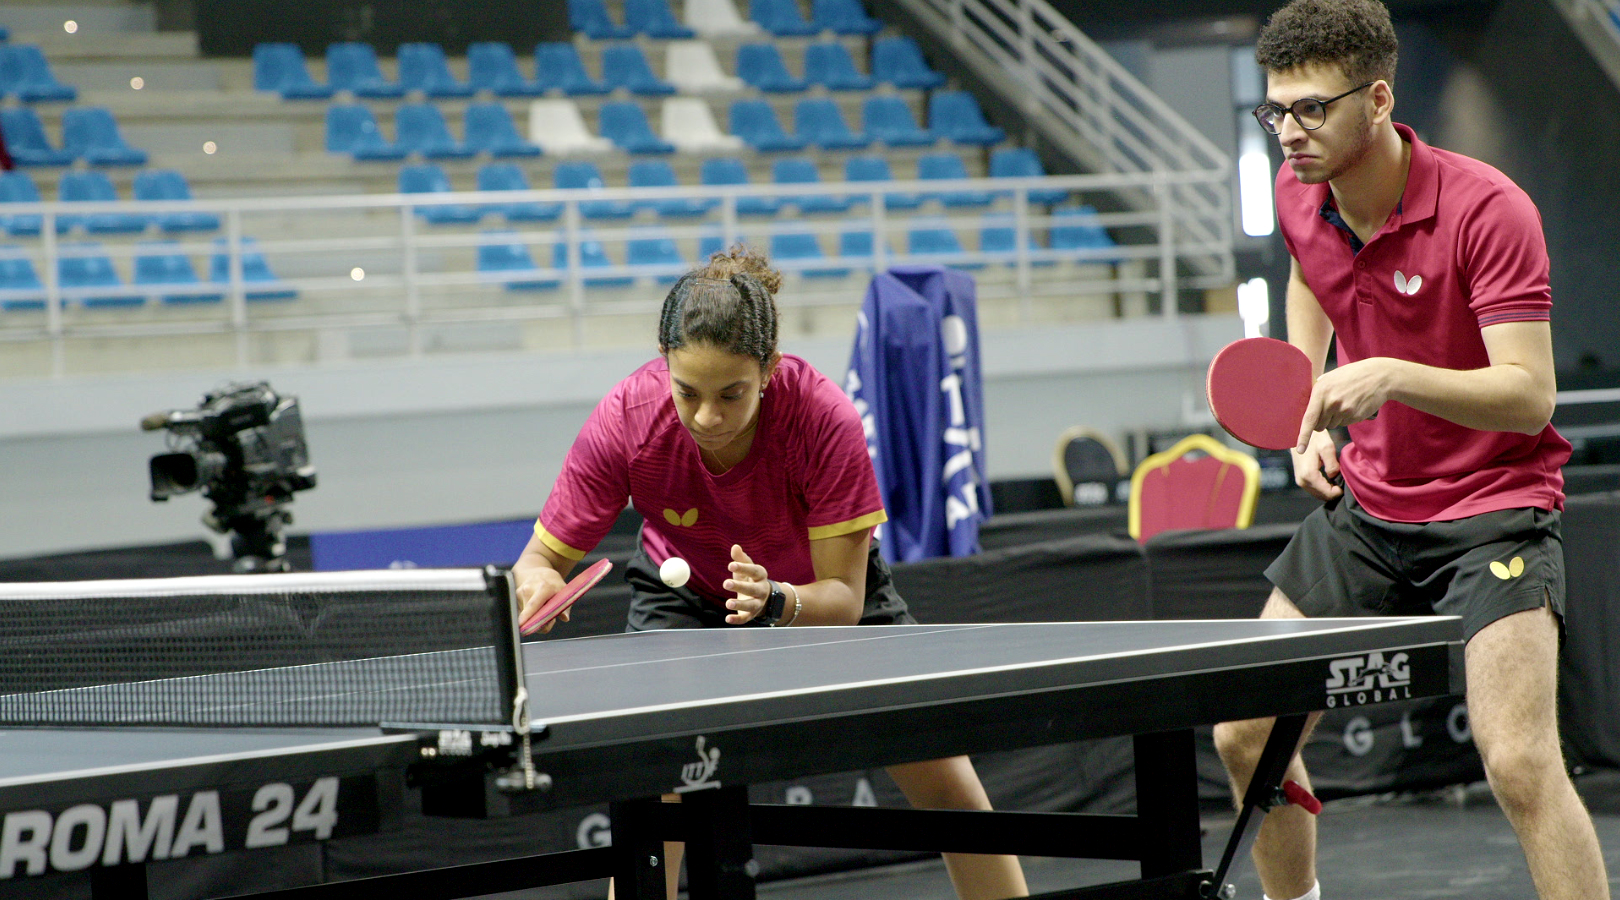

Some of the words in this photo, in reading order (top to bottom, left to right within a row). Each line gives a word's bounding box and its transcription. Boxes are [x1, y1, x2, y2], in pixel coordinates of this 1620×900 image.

[1326, 652, 1410, 689] STAG
[1326, 686, 1411, 708] GLOBAL
[0, 790, 225, 878] ROMA
[245, 777, 340, 848] 24
